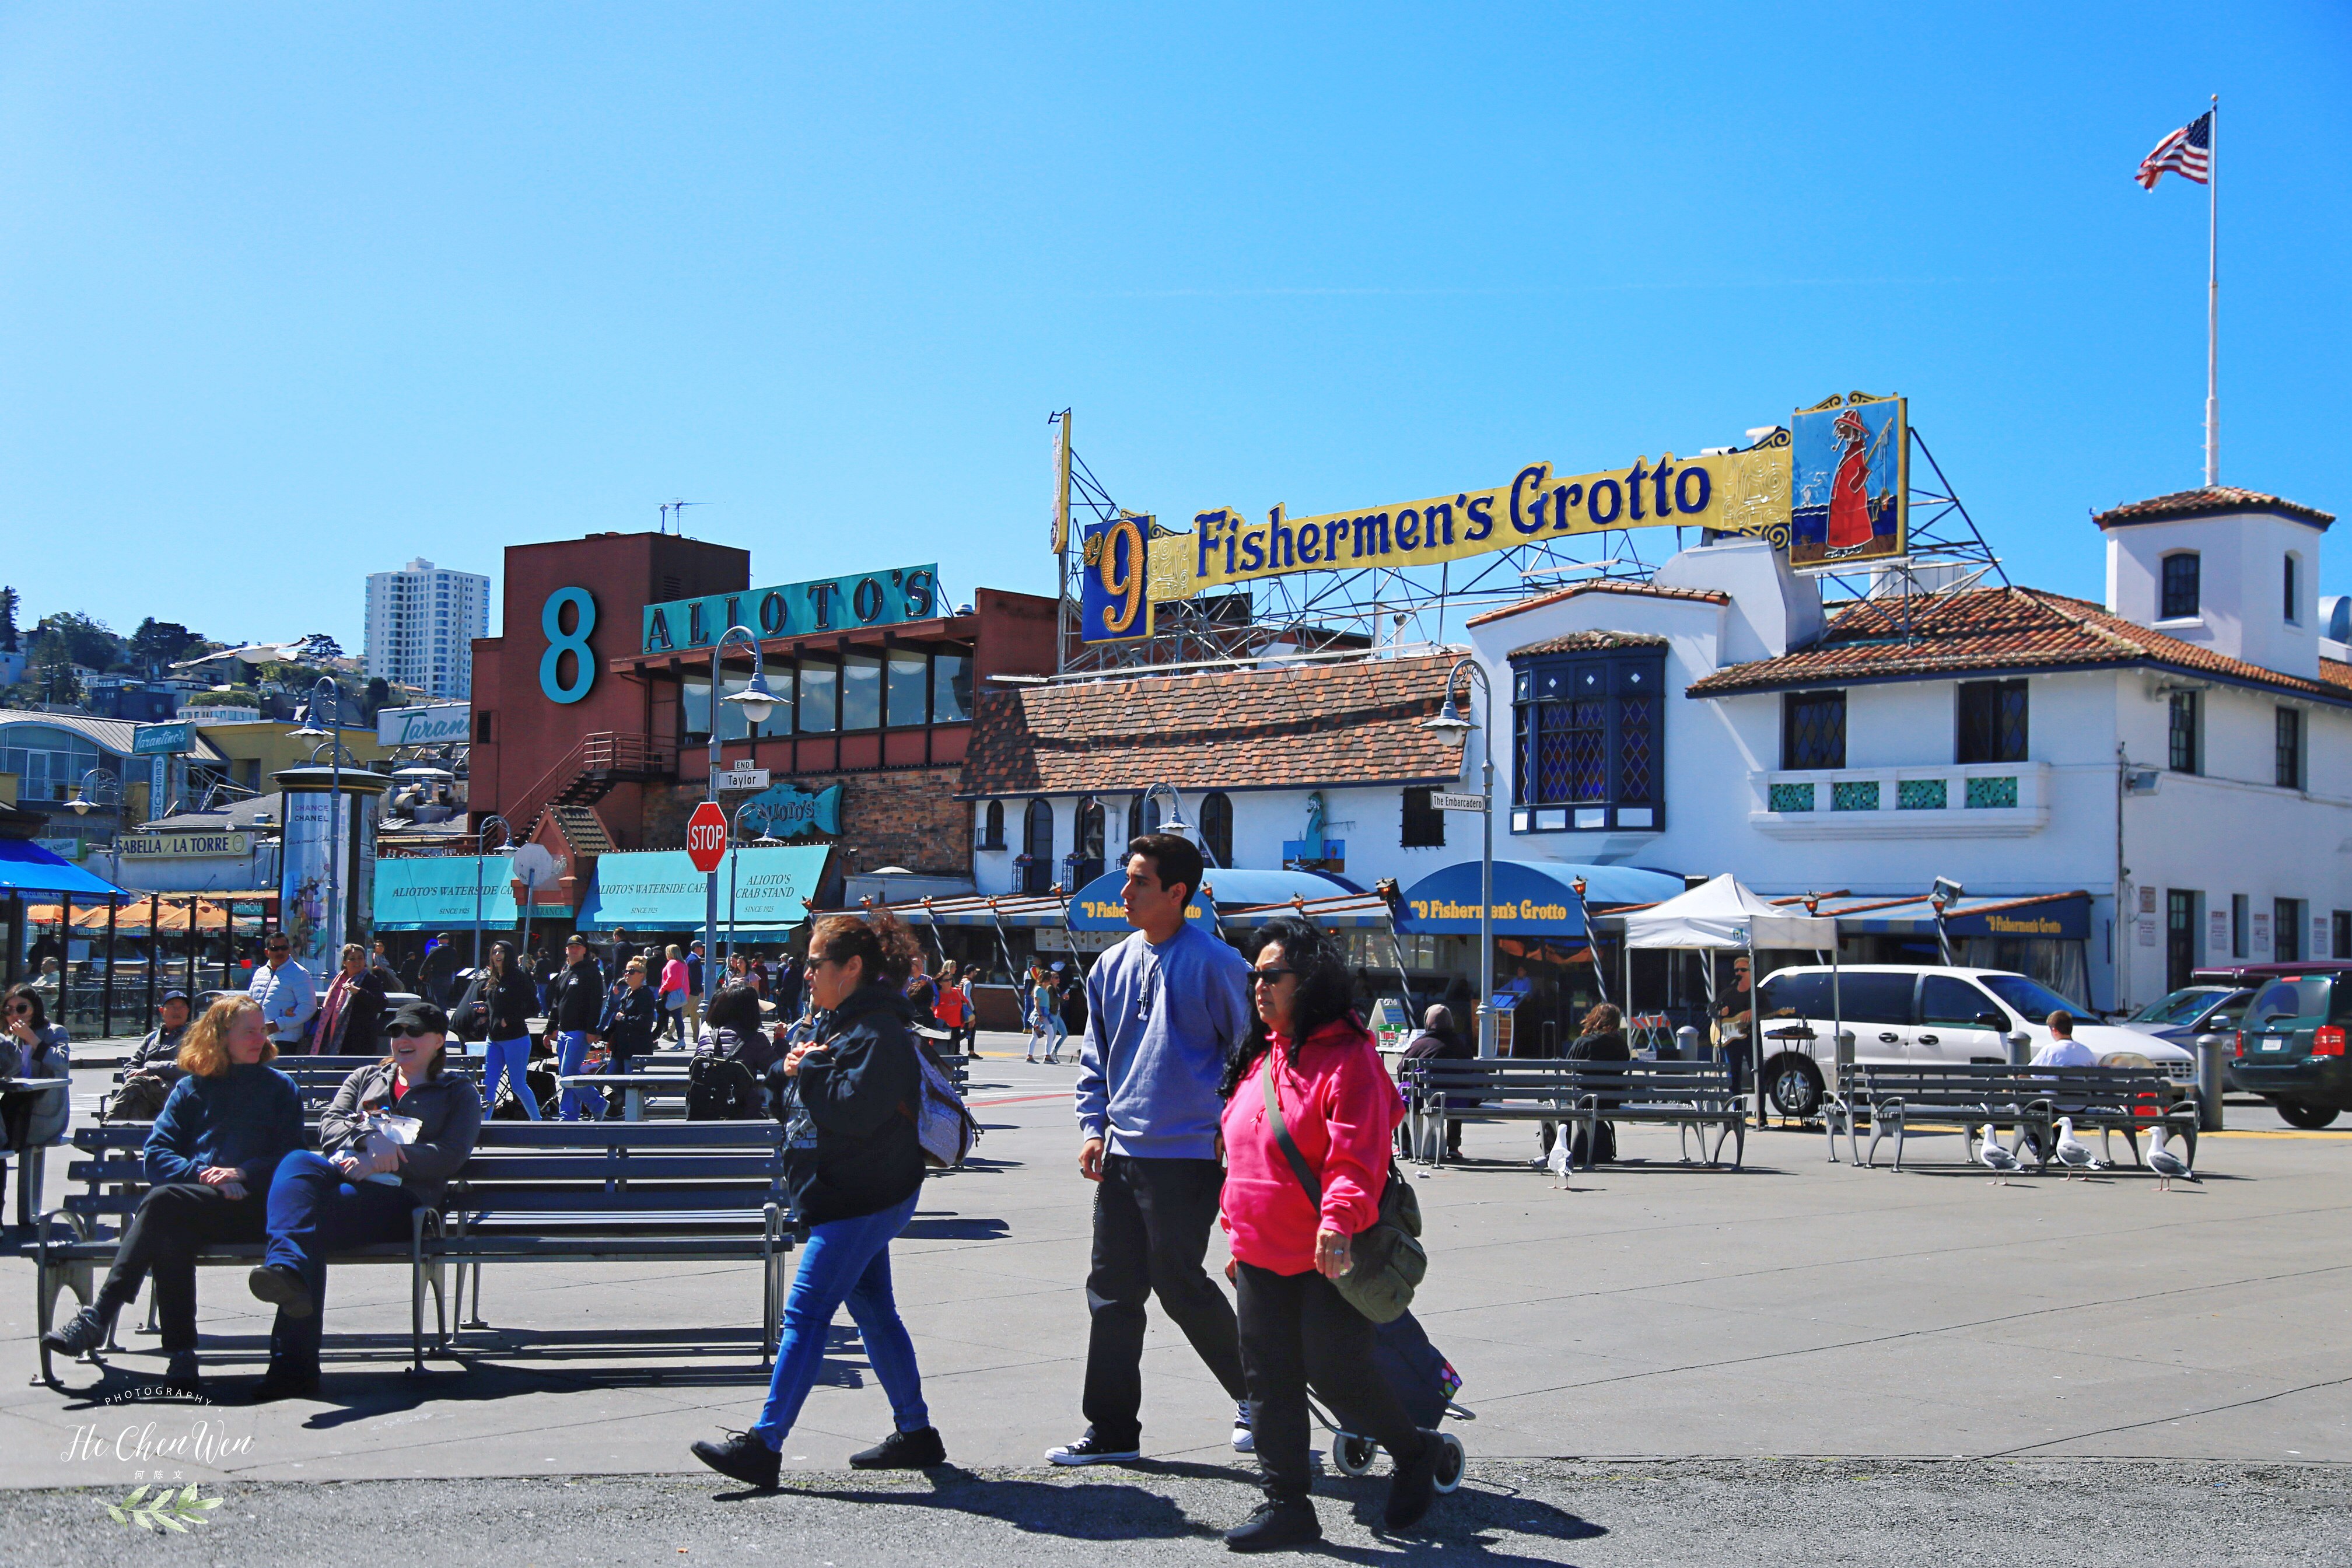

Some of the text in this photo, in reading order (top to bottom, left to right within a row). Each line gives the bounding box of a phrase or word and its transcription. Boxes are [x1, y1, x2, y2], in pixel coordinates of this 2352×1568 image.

[1195, 493, 1494, 578] Fishermen's
[1510, 457, 1711, 536] Grotto
[645, 569, 933, 652] ALIOTO'S
[540, 586, 596, 704] 8
[135, 728, 186, 752] Tarantino's
[728, 775, 757, 788] Taylor
[154, 760, 164, 822] RESTAURA
[1433, 796, 1482, 808] The Embarcadero
[173, 838, 187, 853] LA
[190, 836, 229, 852] TORRE
[690, 824, 724, 850] STOP
[746, 874, 792, 886] ALIOTO'S
[393, 886, 438, 897] ALIOTO'S
[440, 885, 498, 896] WATERSDE
[594, 884, 635, 895] ALIOTO'S
[635, 883, 687, 894] WATERSIDE
[736, 887, 794, 899] CRAB STAND
[1184, 905, 1202, 919] otto
[1520, 899, 1567, 920] Grotto
